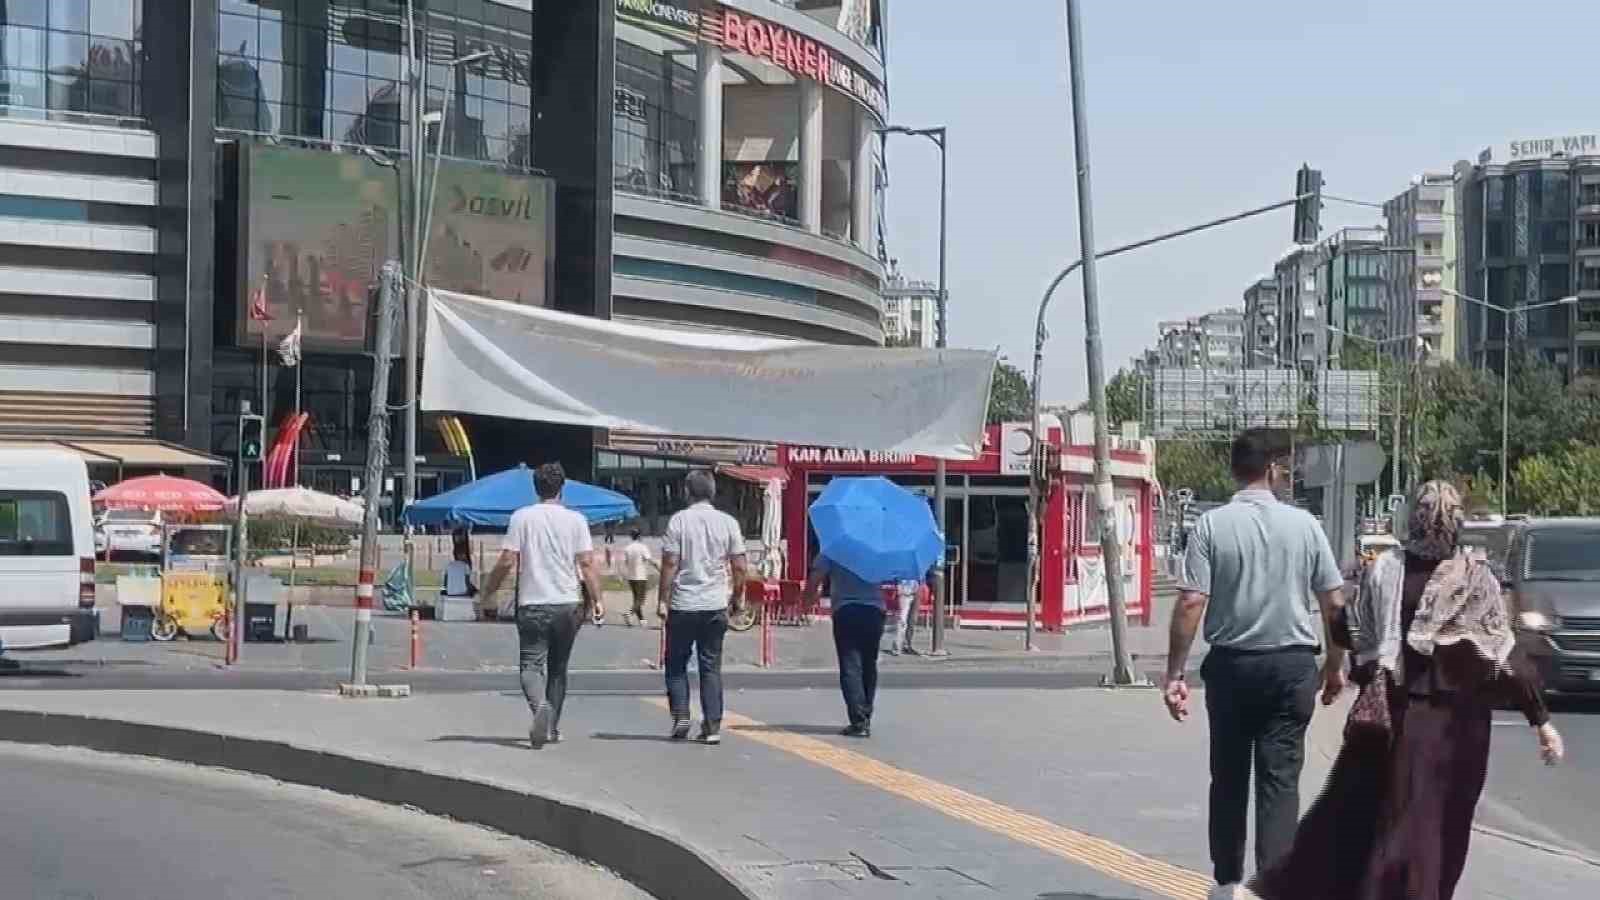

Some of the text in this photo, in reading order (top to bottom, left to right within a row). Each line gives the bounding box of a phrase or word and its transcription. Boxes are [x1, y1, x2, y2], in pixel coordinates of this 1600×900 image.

[724, 11, 831, 85] BOYNER
[788, 447, 820, 463] KAN
[824, 448, 866, 464] ALMA
